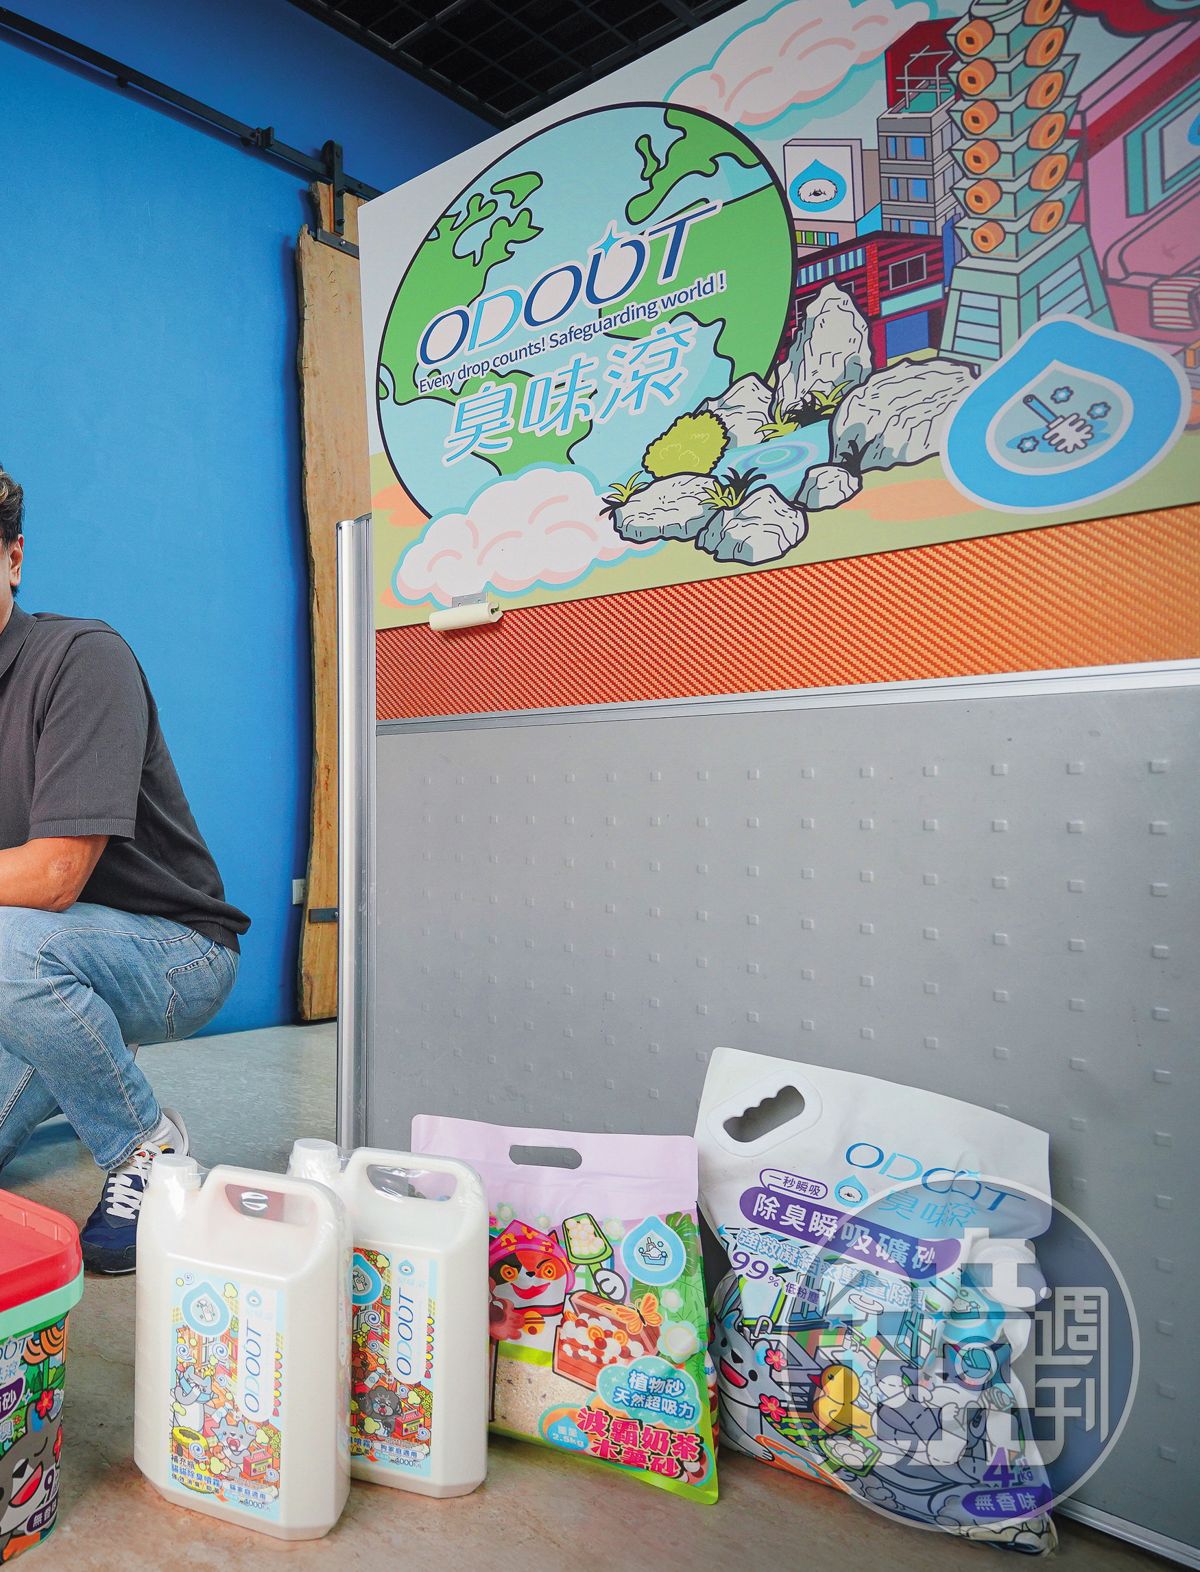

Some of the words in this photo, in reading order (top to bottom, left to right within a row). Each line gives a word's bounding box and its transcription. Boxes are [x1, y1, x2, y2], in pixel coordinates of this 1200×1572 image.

[419, 205, 717, 365] ODOUT
[419, 370, 455, 393] Every
[457, 360, 490, 380] drop
[493, 337, 546, 367] counts!
[550, 301, 658, 349] Safeguarding
[446, 327, 693, 463] 臭味滾
[768, 1174, 821, 1197] 一秒瞬吸
[752, 1193, 938, 1273] 除臭瞬吸礦砂
[732, 1251, 781, 1288] 99%
[243, 1318, 262, 1413] ODOUT
[397, 1287, 414, 1376] ODOUT
[612, 1387, 696, 1420] 天然超吸力
[628, 1370, 686, 1398] 植物砂
[577, 1406, 701, 1462] 波霸奶茶
[974, 1491, 1037, 1512] 無香味
